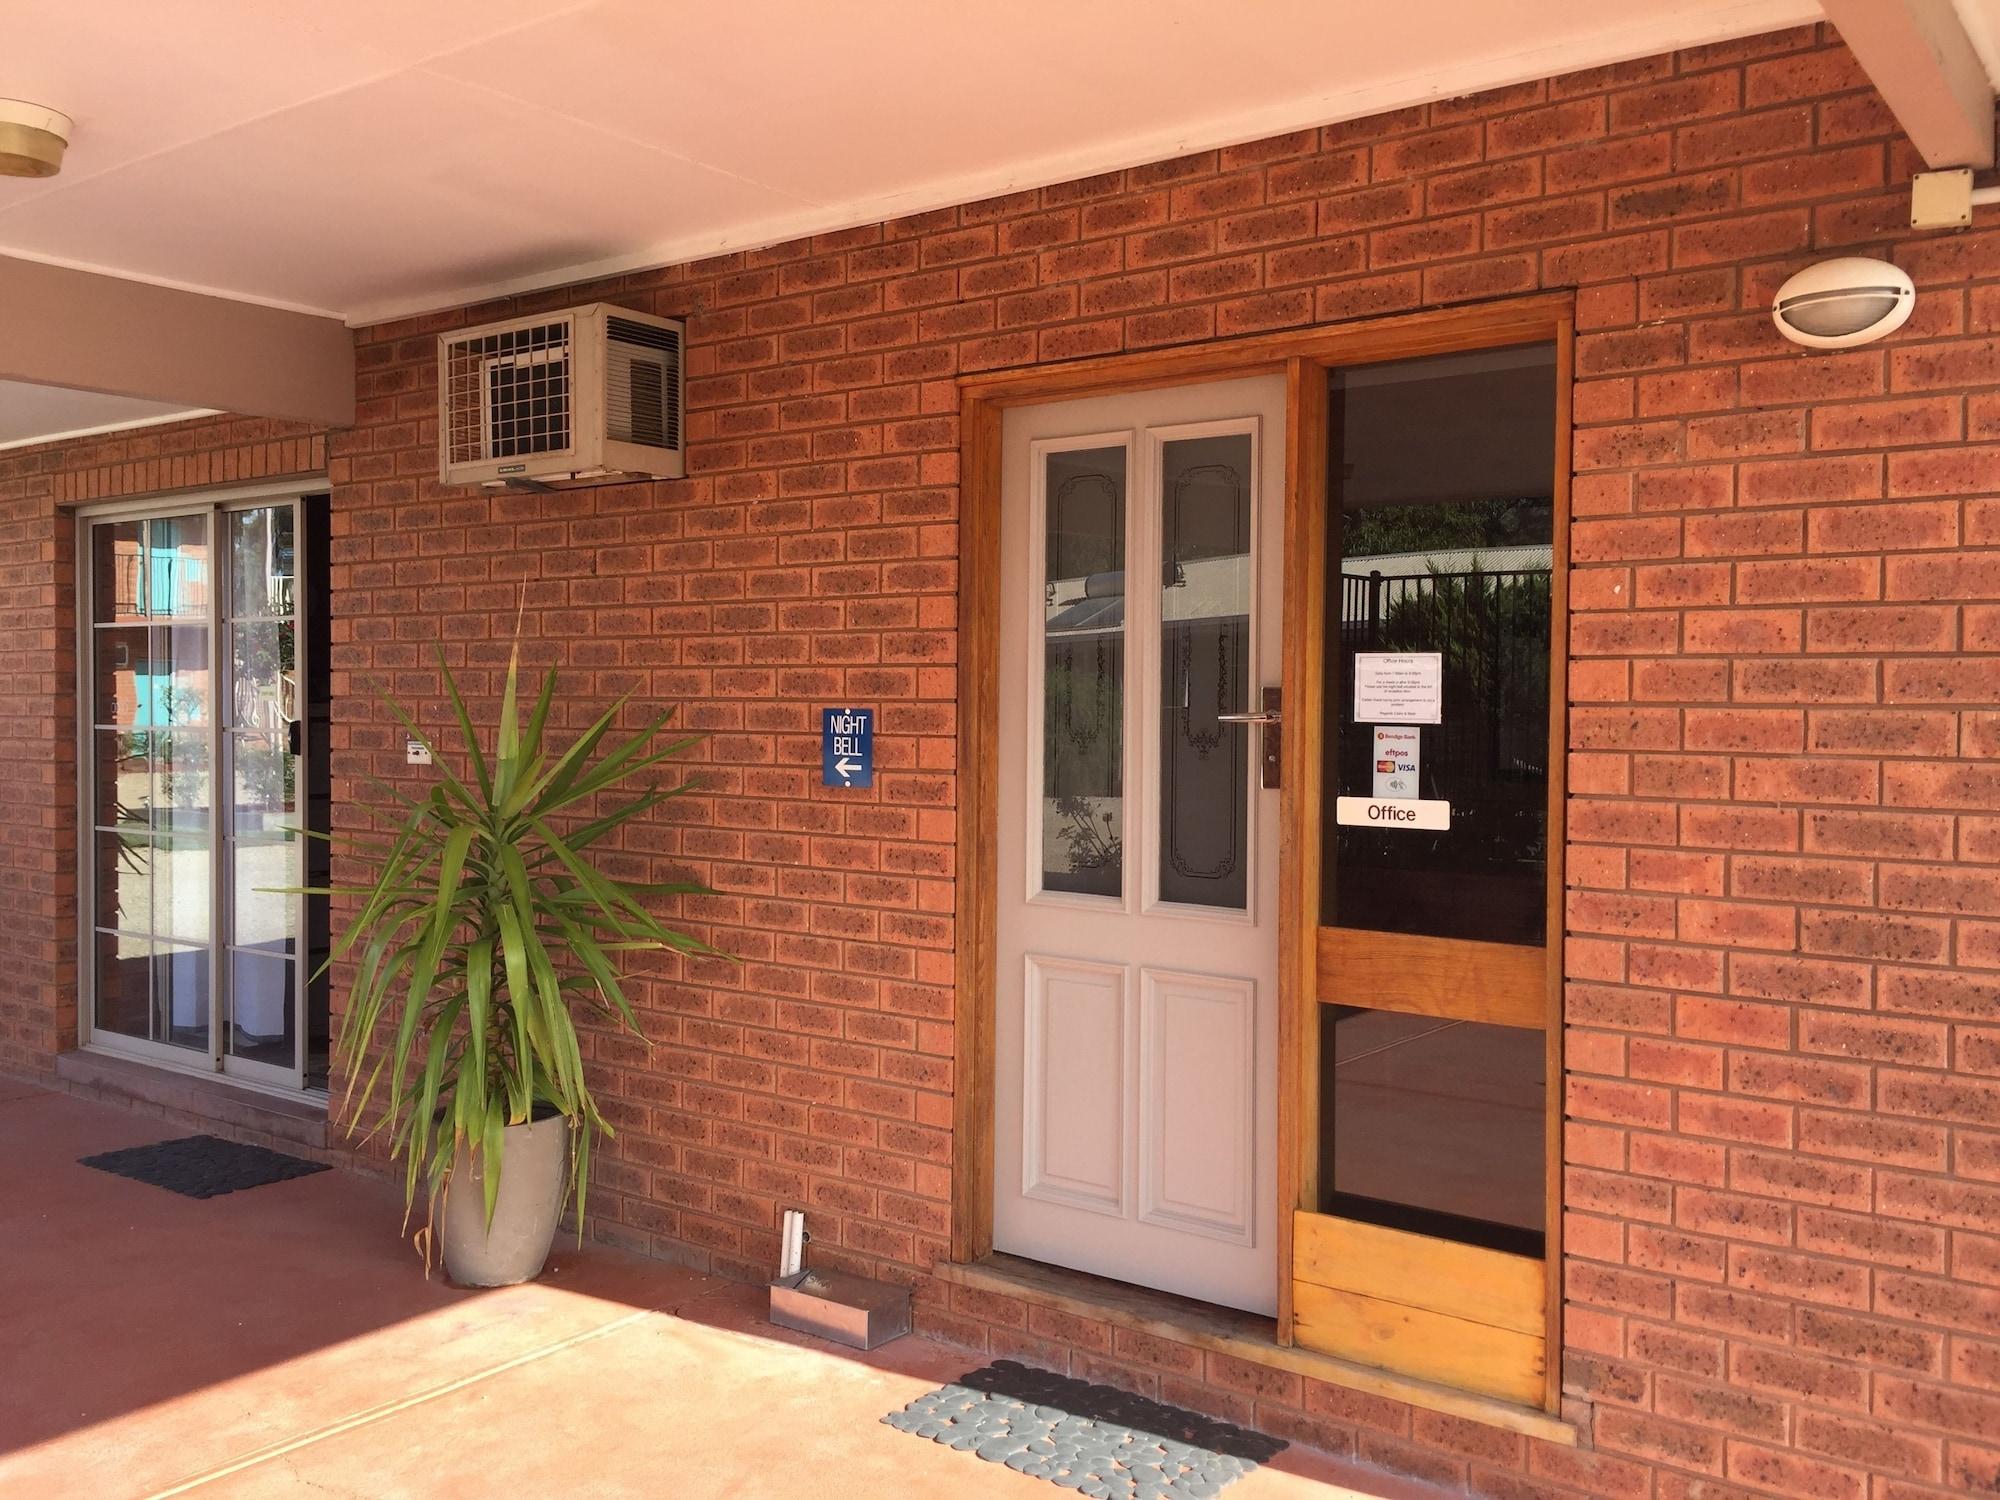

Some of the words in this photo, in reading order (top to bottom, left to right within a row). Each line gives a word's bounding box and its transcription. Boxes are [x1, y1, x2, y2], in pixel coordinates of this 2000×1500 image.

[830, 715, 867, 735] NIGHT
[833, 736, 863, 757] BELL
[1384, 748, 1409, 757] eftpos
[1398, 764, 1416, 772] VISA
[1368, 804, 1416, 821] Office
